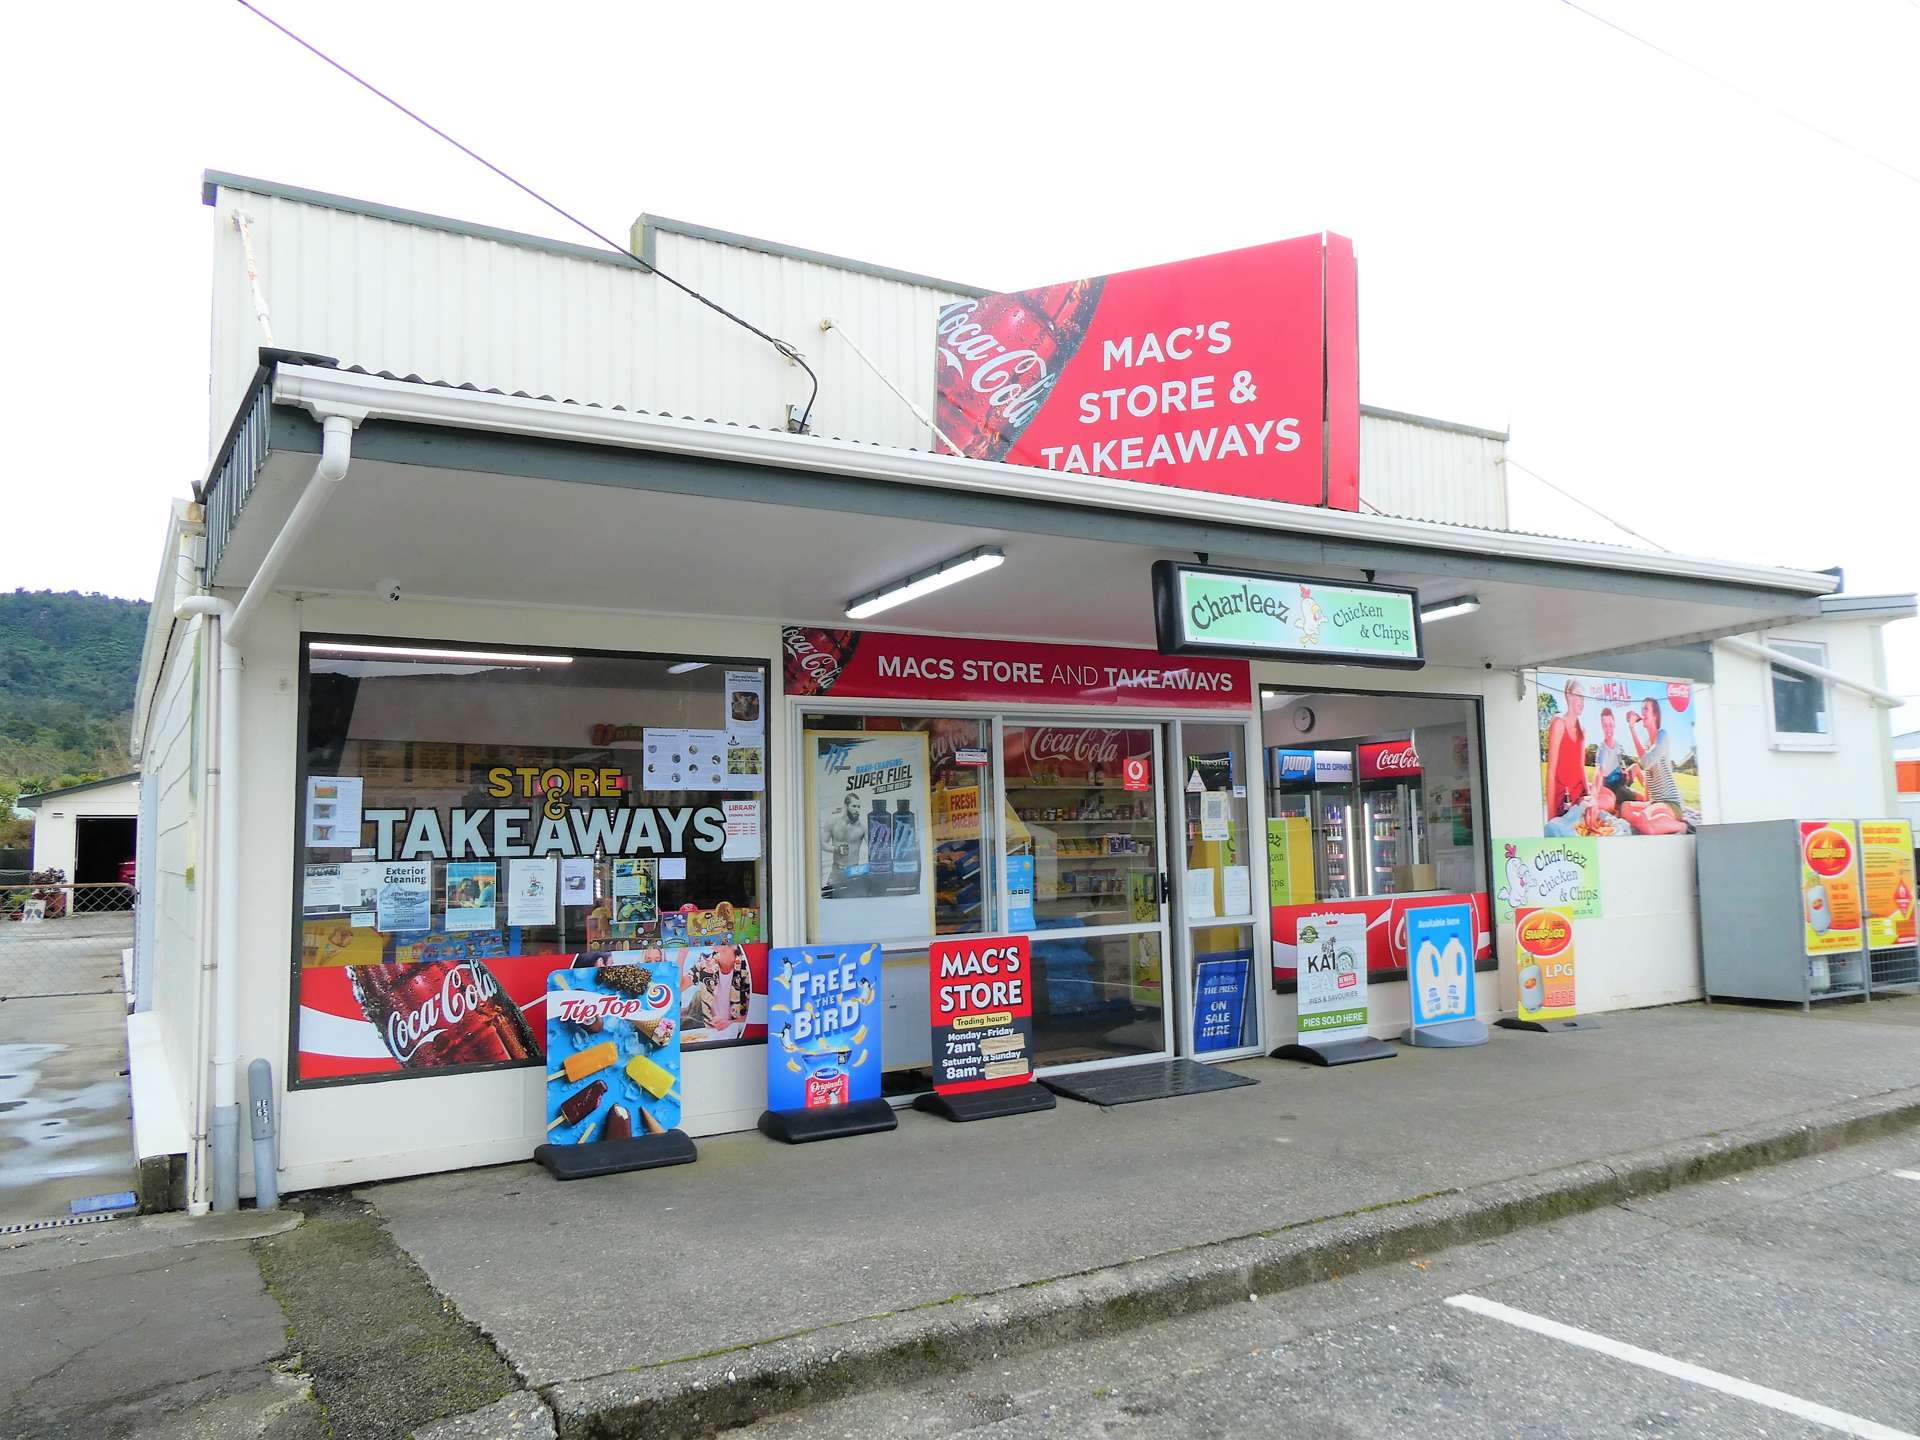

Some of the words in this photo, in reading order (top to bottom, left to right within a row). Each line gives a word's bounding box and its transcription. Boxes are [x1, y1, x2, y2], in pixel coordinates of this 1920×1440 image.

[1103, 320, 1232, 371] MAC'S
[1078, 375, 1215, 425] STORE
[1229, 370, 1257, 405] &
[1040, 417, 1301, 474] TAKEAWAYS
[1190, 584, 1291, 630] Charleez
[1332, 602, 1383, 628] Chicken
[1359, 624, 1370, 639] &
[1372, 623, 1409, 645] Chips
[878, 655, 955, 680] MACS
[962, 660, 1044, 684] STORE
[1050, 664, 1098, 686] AND
[1103, 667, 1233, 692] TAKEAWAYS
[1281, 755, 1312, 775] pump
[487, 767, 622, 798] STORE
[846, 770, 884, 791] SUPER
[887, 764, 913, 783] FUEL
[543, 786, 571, 821] &
[950, 791, 976, 811] FRESH
[363, 806, 726, 860] TAKEAWAYS
[1534, 844, 1588, 871] Charleez
[384, 875, 427, 884] Cleaning
[386, 866, 425, 875] Exterior
[1538, 869, 1578, 897] Chicken
[1560, 887, 1568, 903] &
[1569, 886, 1599, 906] Chips
[940, 946, 1021, 978] MAC'S
[1307, 952, 1336, 973] KAI
[1545, 963, 1574, 978] LPG
[791, 962, 858, 1011] FREE
[939, 979, 1023, 1013] STORE
[388, 958, 498, 1062] Coca-Cola
[559, 998, 598, 1023] Tip
[598, 996, 641, 1018] Top
[815, 995, 835, 1009] THE
[1210, 1000, 1227, 1011] ON
[794, 1000, 860, 1040] BiRD
[956, 1016, 985, 1027] Trading
[986, 1015, 1009, 1024] hours:
[1204, 1012, 1231, 1024] SALE
[1303, 1017, 1321, 1028] PIES
[1321, 1015, 1342, 1026] SOLD
[1343, 1011, 1364, 1022] HERE
[947, 1031, 983, 1042] Monday
[987, 1027, 1015, 1038] Friday
[1202, 1024, 1231, 1037] HERE
[942, 1055, 983, 1068] Saturday
[990, 1050, 1021, 1062] Sunday
[945, 1042, 976, 1055] 7am
[946, 1066, 977, 1080] 8am
